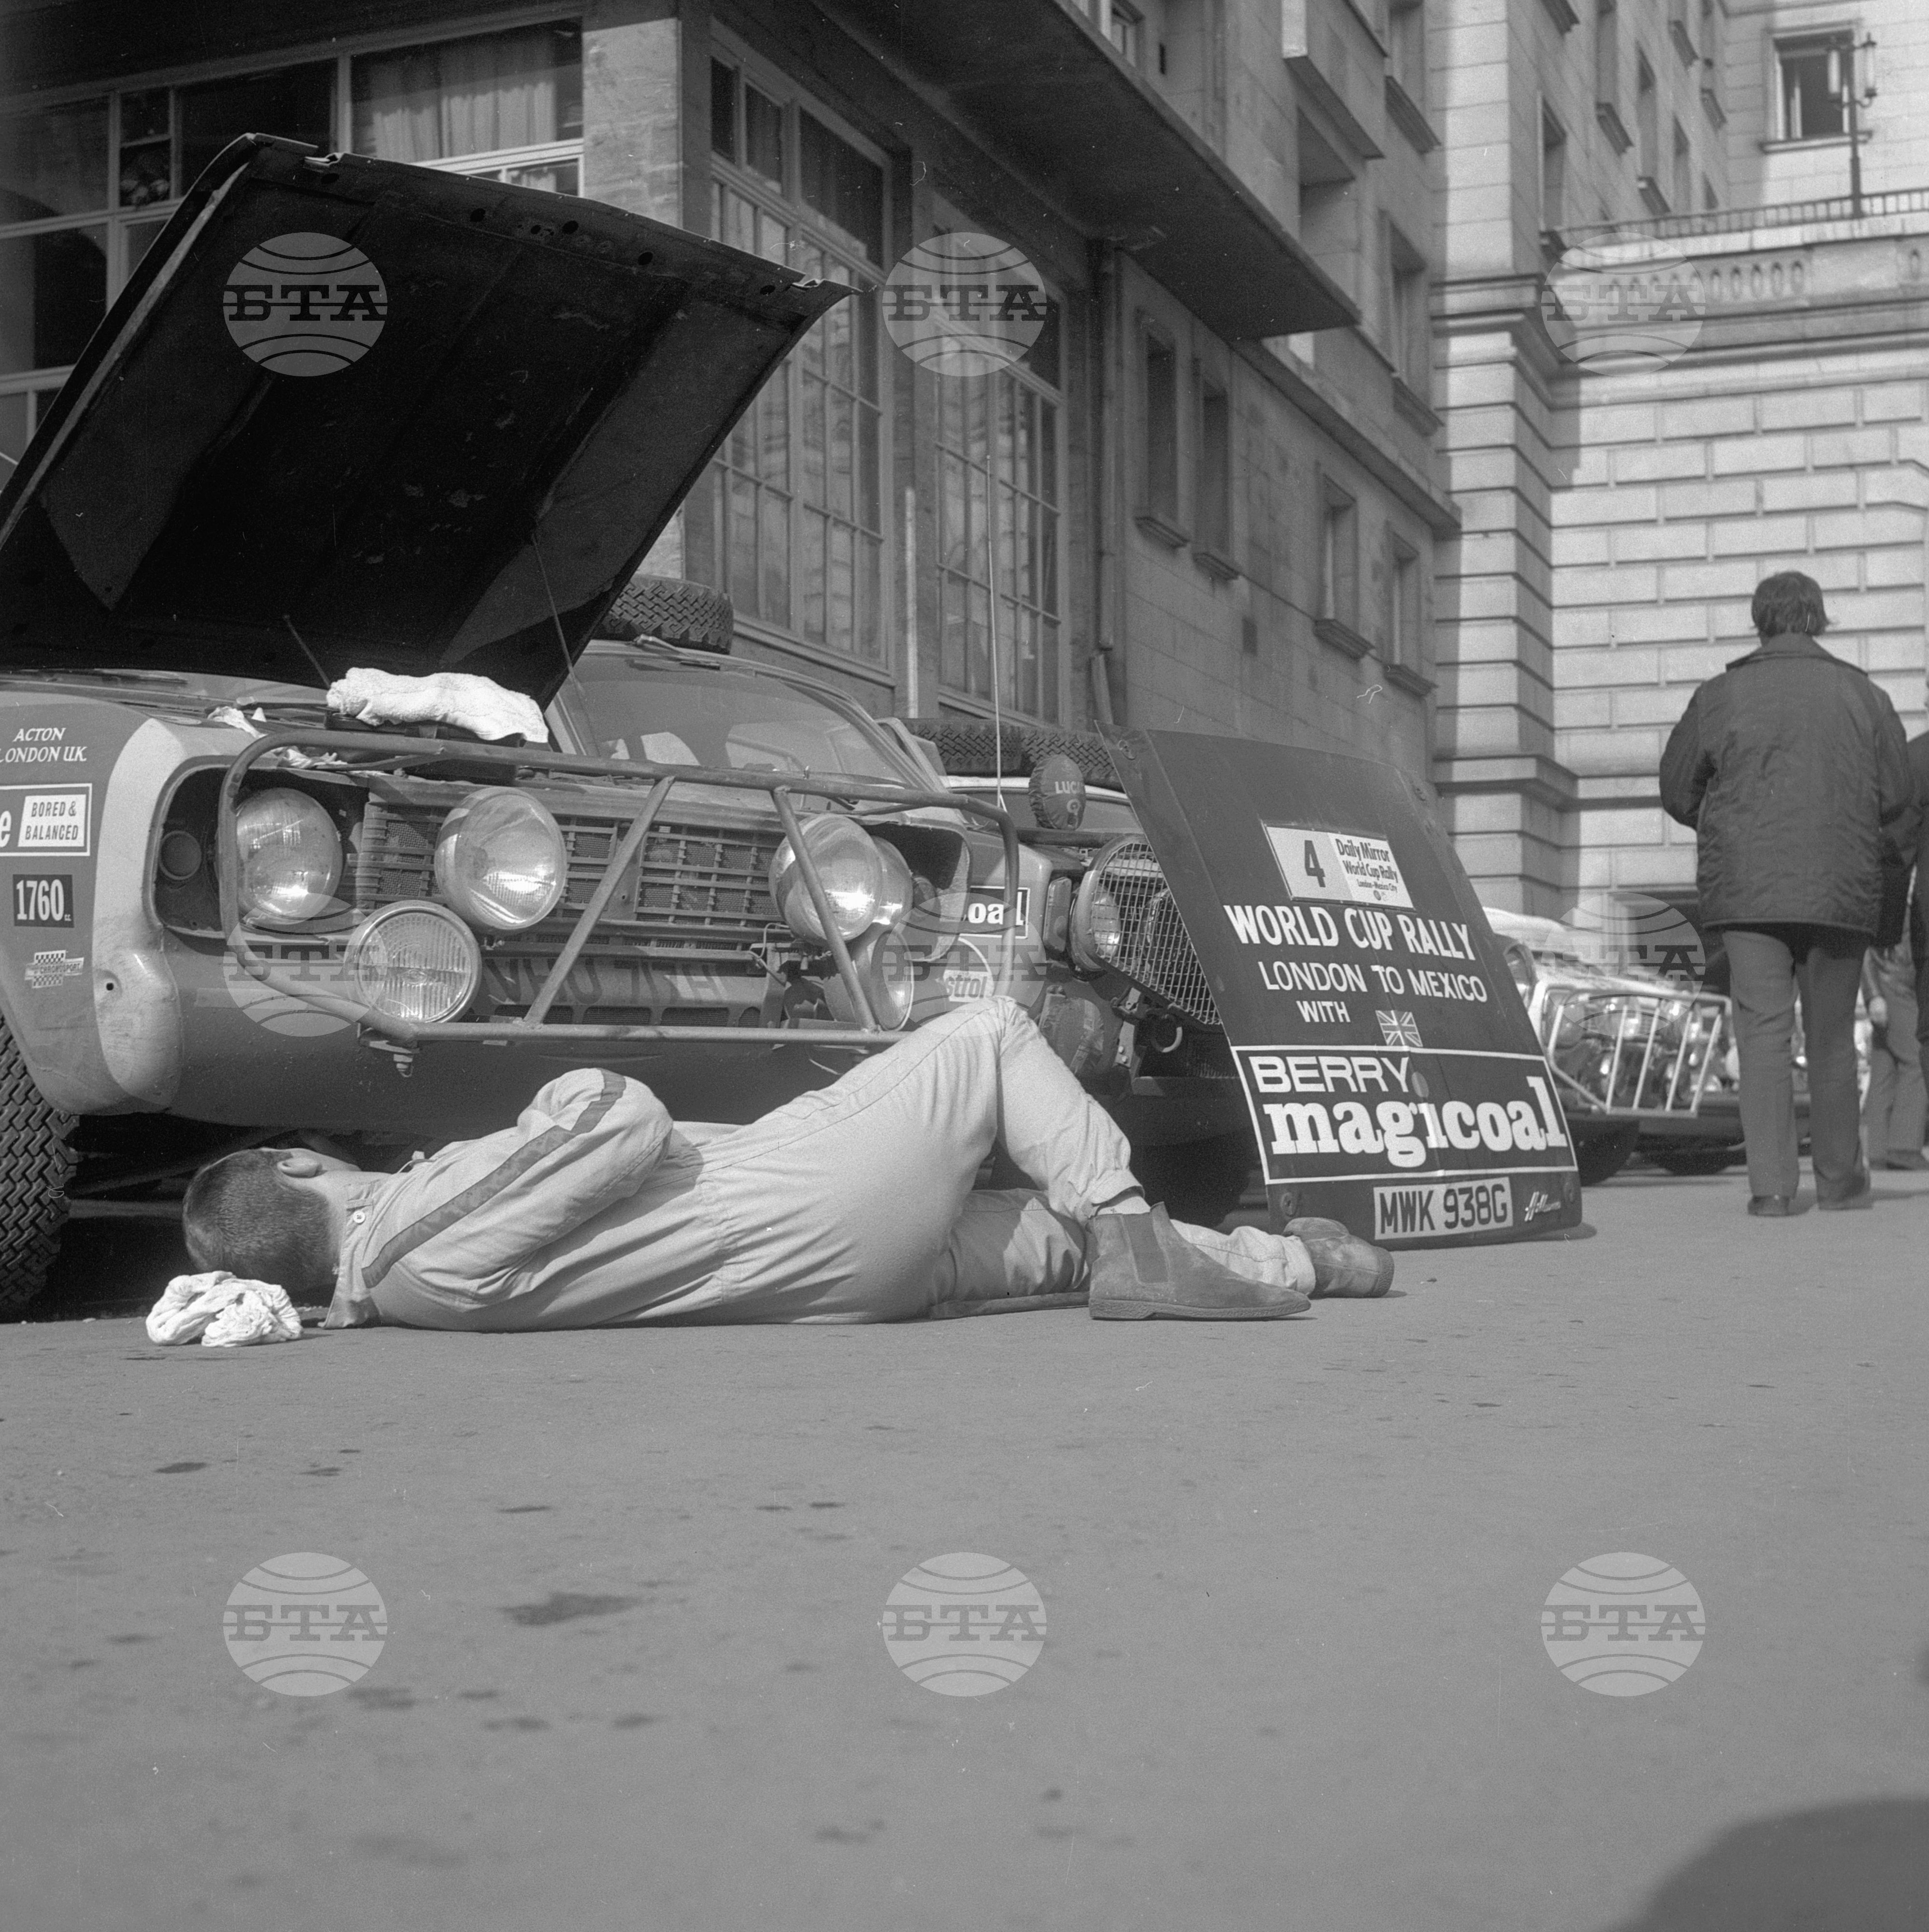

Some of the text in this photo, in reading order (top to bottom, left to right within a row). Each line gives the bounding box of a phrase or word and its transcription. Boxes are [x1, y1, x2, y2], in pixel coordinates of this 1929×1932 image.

[13, 728, 66, 742] ACTON
[31, 801, 76, 817] BORED &
[25, 824, 78, 840] BALANCED
[1335, 838, 1390, 862] Daily Mirror
[1305, 839, 1326, 887] 4
[1343, 860, 1398, 883] World Cup Rally
[16, 879, 64, 921] 1760
[1223, 905, 1476, 961] WORLD CUP RALLY
[1258, 961, 1488, 1003] LONDON TO MEXICO
[1295, 1000, 1351, 1023] WITH
[1248, 1056, 1409, 1093] BERRY
[1262, 1076, 1568, 1168] magicoal
[1379, 1183, 1508, 1234] MWK 938G
